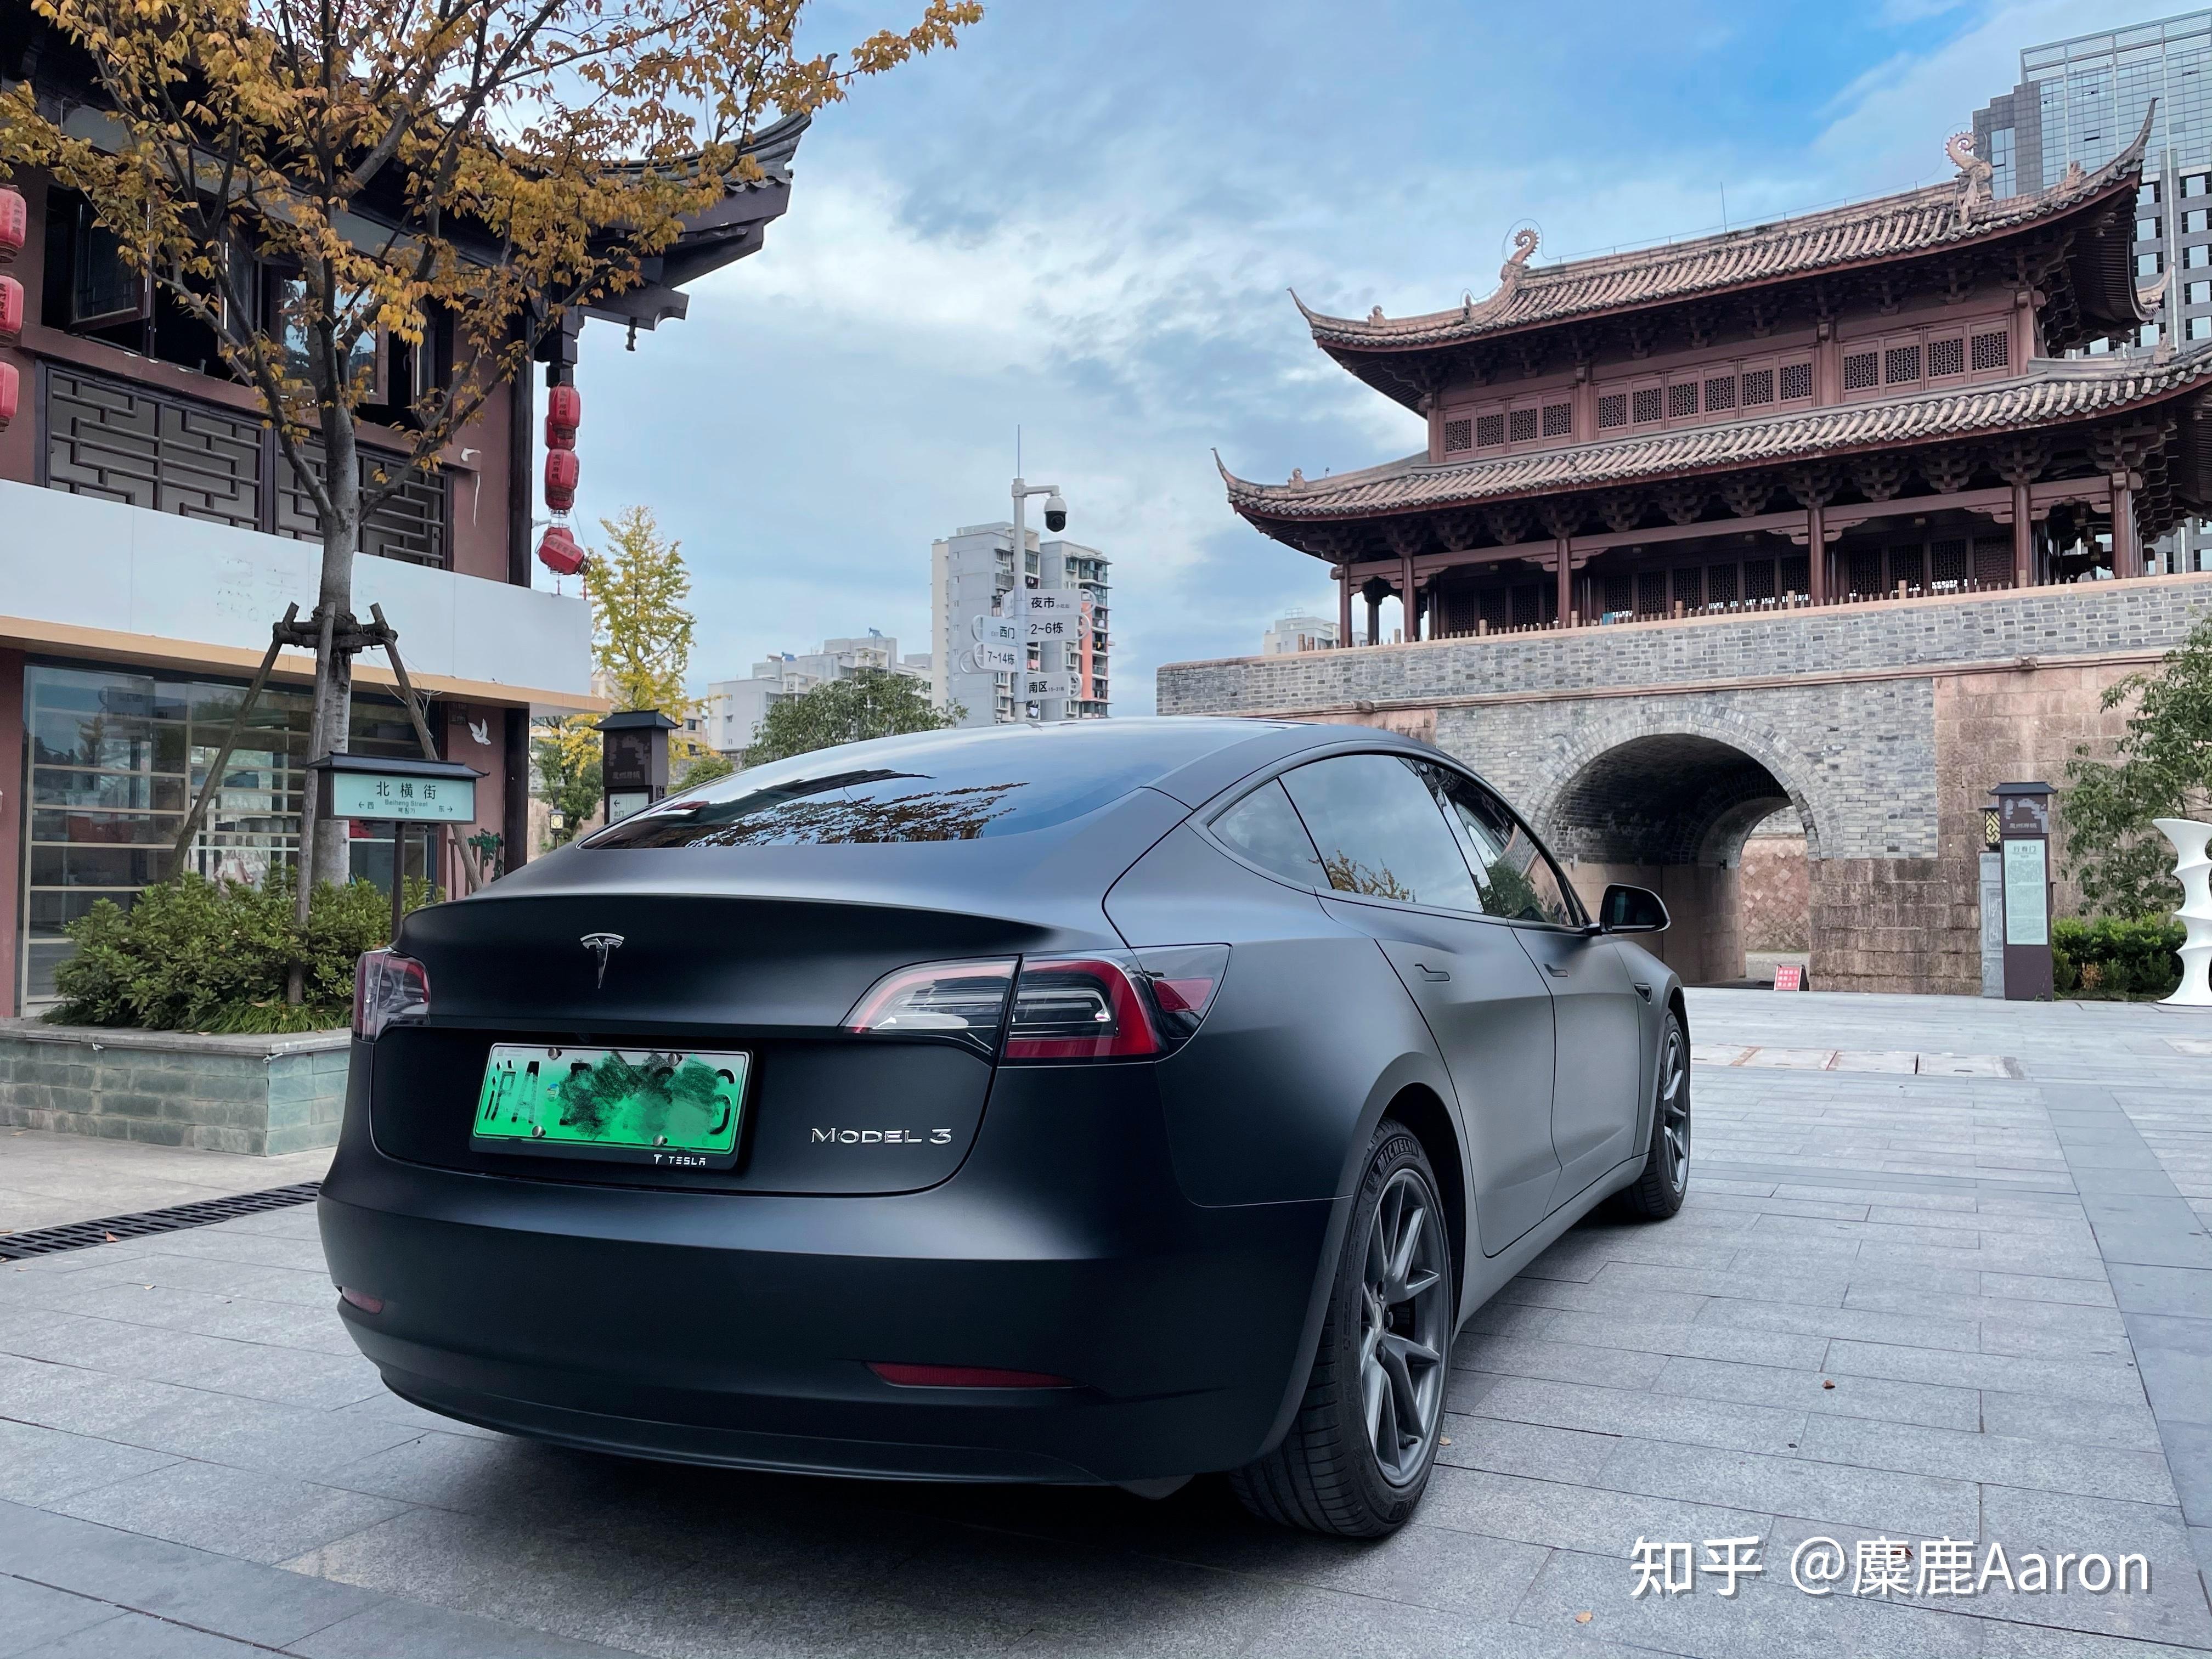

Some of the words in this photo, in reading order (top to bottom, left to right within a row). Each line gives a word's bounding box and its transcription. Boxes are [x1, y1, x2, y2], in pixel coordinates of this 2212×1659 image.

[1031, 596, 1055, 608] 夜市
[1000, 626, 1015, 639] 西门
[1030, 622, 1063, 635] 2~6栋
[988, 651, 1015, 665] 7~14栋
[1029, 681, 1047, 693] 南区
[376, 781, 436, 799] 北横街
[385, 799, 409, 807] Beiheng
[810, 1127, 923, 1144] MODEL
[929, 1128, 952, 1144] 3
[668, 1156, 706, 1166] TESLA
